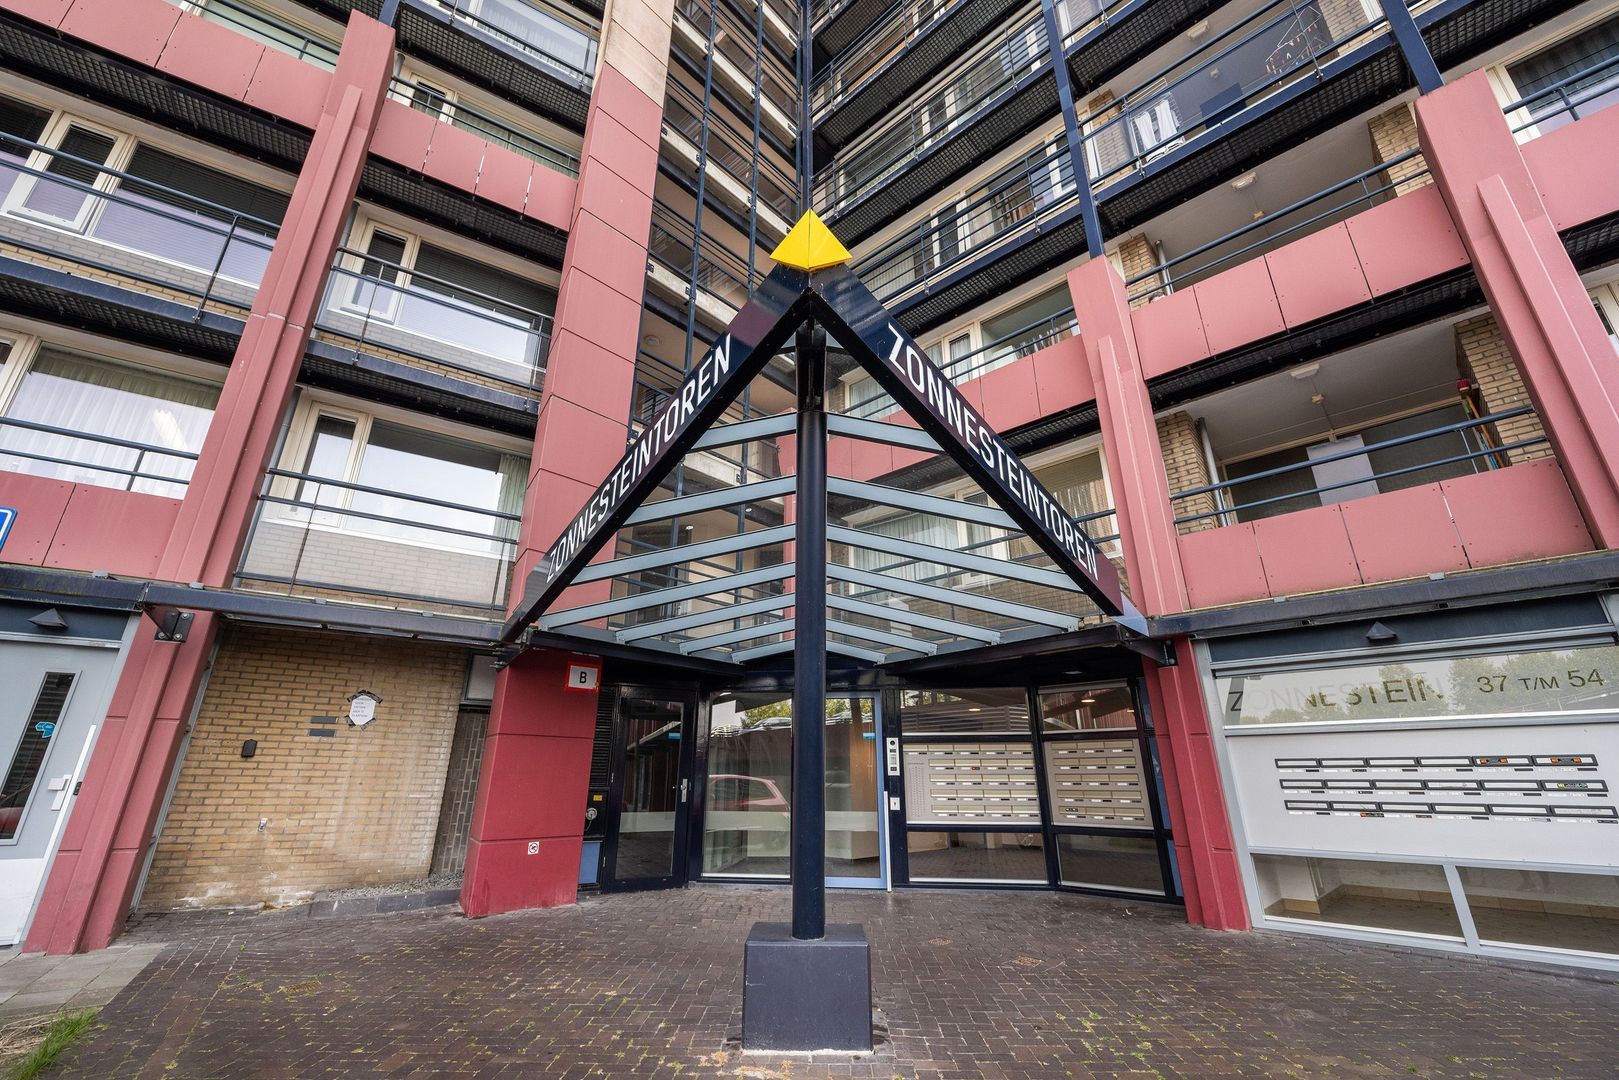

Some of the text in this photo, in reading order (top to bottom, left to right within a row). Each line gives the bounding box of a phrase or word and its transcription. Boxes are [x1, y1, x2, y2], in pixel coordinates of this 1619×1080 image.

[546, 333, 731, 584] ZONNESTEINTOREN
[888, 322, 1099, 581] ZONNESTEINTOREN
[579, 671, 588, 684] B
[1477, 675, 1507, 693] 37
[1518, 676, 1560, 691] T/M
[1567, 668, 1606, 688] 54
